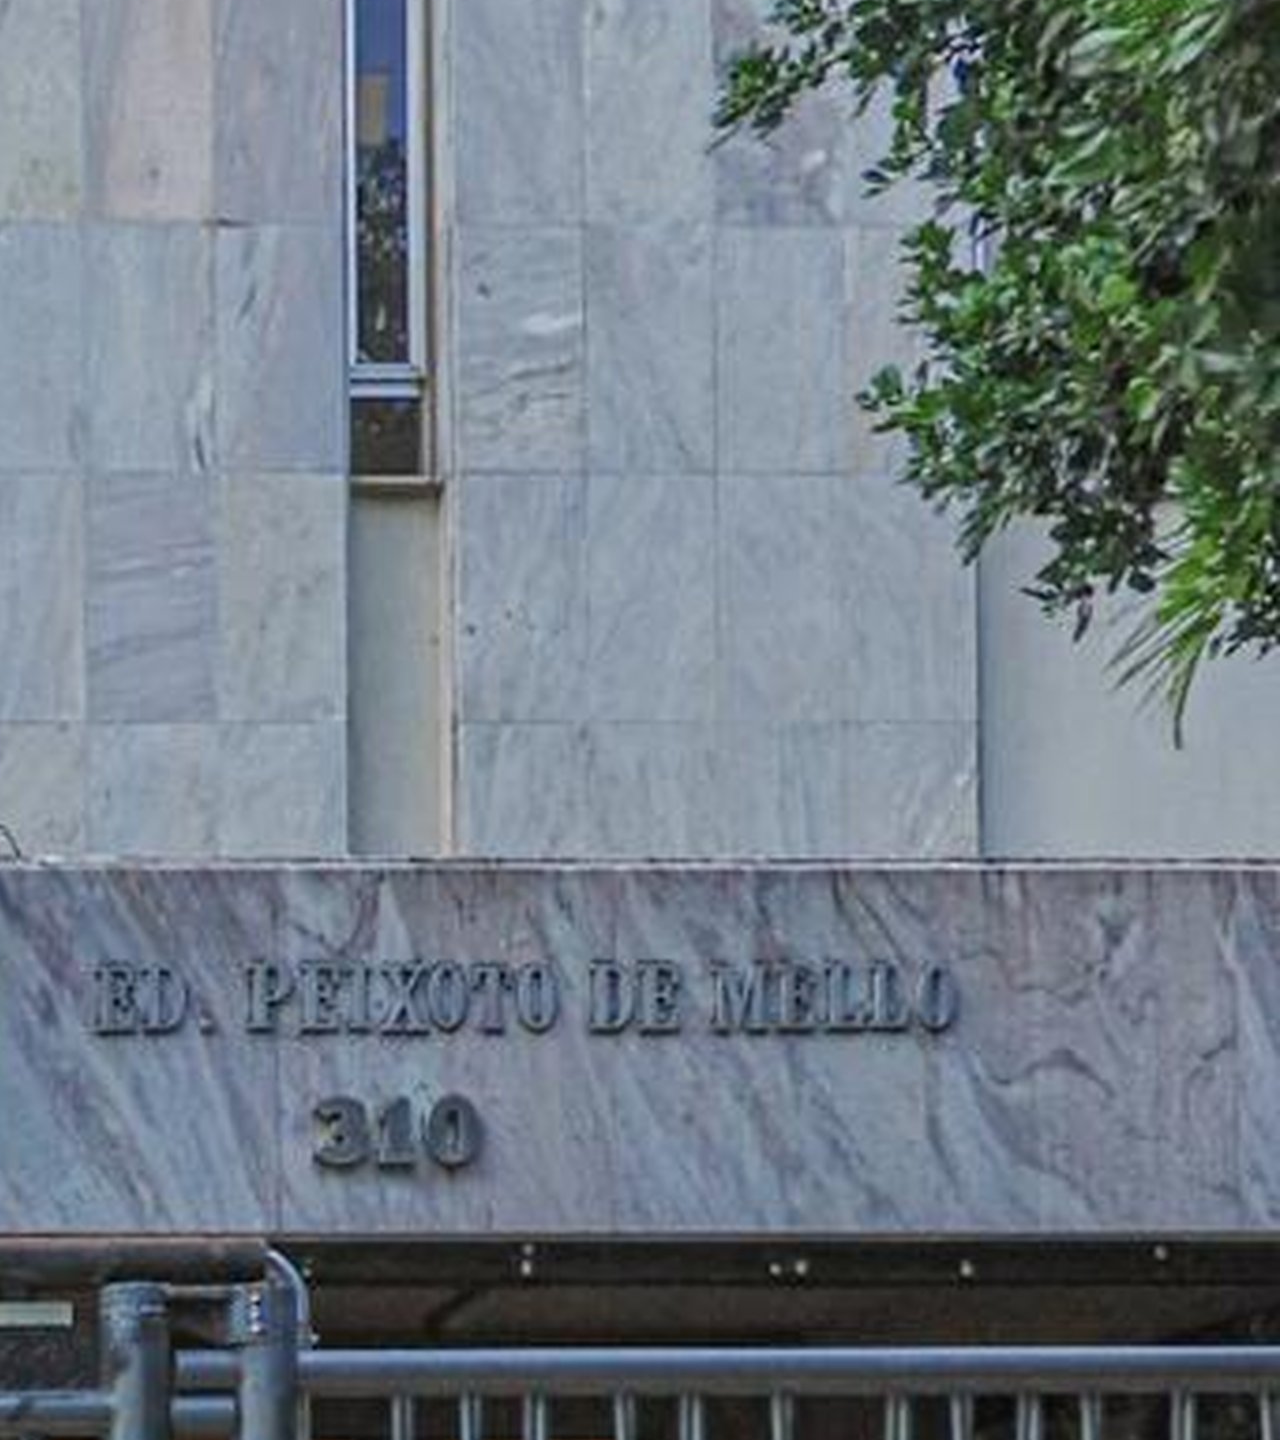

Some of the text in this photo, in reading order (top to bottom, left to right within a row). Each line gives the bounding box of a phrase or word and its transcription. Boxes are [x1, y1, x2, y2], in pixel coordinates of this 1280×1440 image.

[90, 960, 958, 1035] ED. PEIXOTO DE MELLO
[311, 1093, 484, 1168] 310
